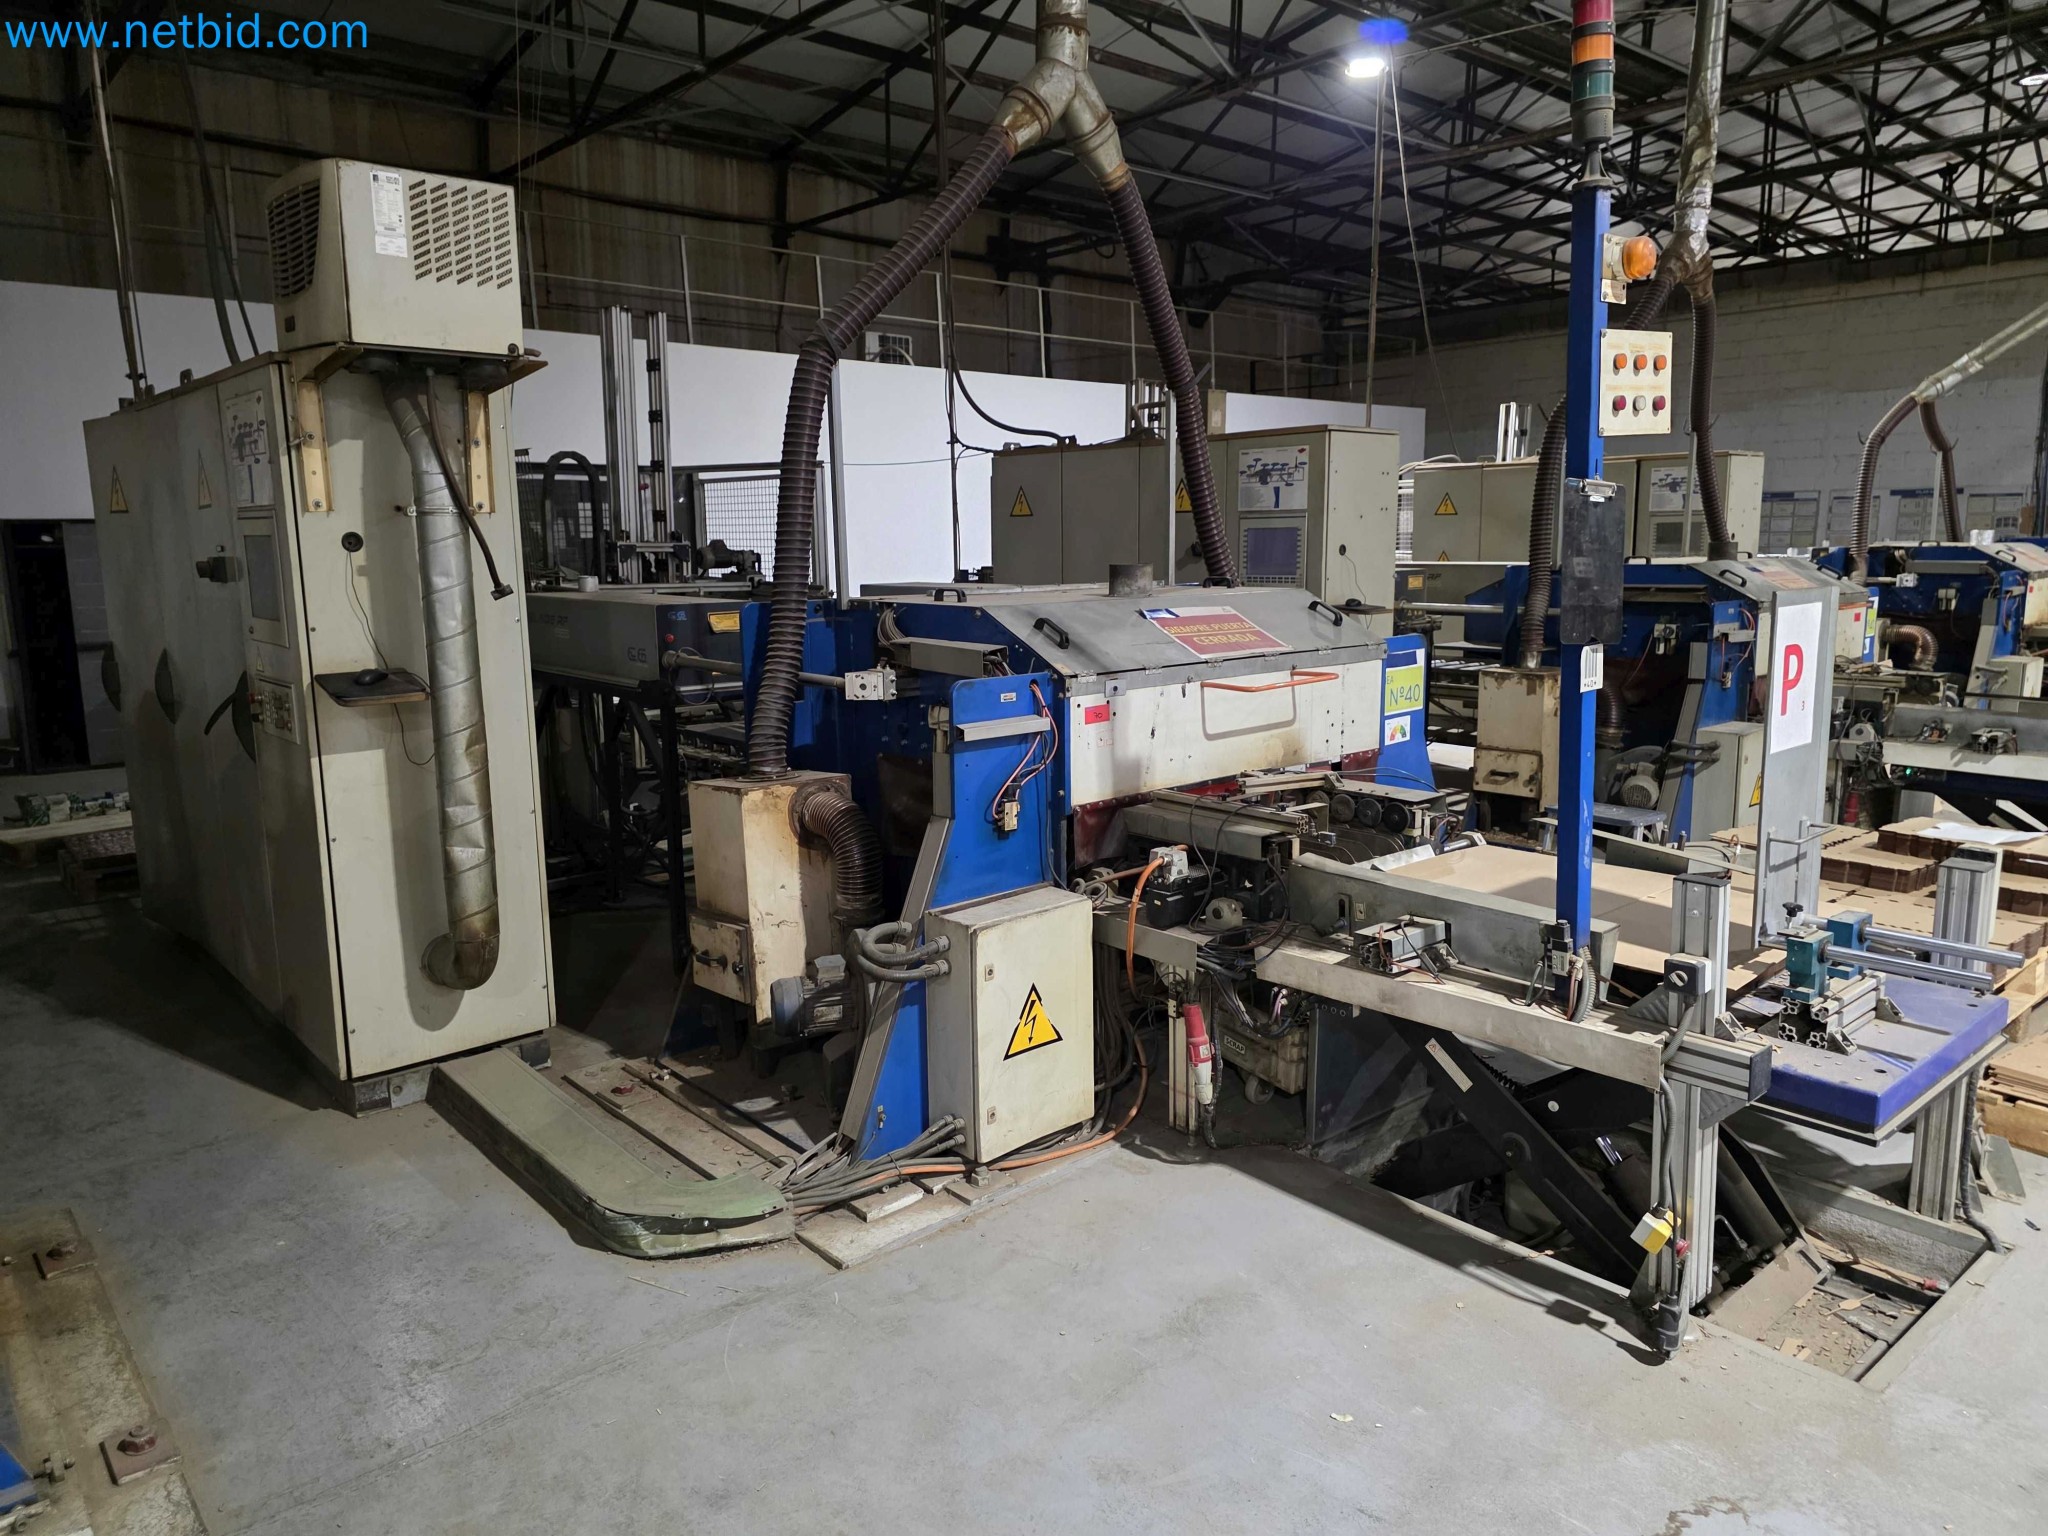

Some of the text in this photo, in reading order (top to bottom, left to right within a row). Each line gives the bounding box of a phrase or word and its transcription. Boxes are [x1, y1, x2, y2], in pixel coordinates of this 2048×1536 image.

[1164, 621, 1252, 634] SIEMPRE PUERTA
[1192, 633, 1262, 645] CERRADA
[1780, 643, 1804, 717] P
[1389, 683, 1421, 707] Nº40
[1225, 1036, 1246, 1053] SCRAP
